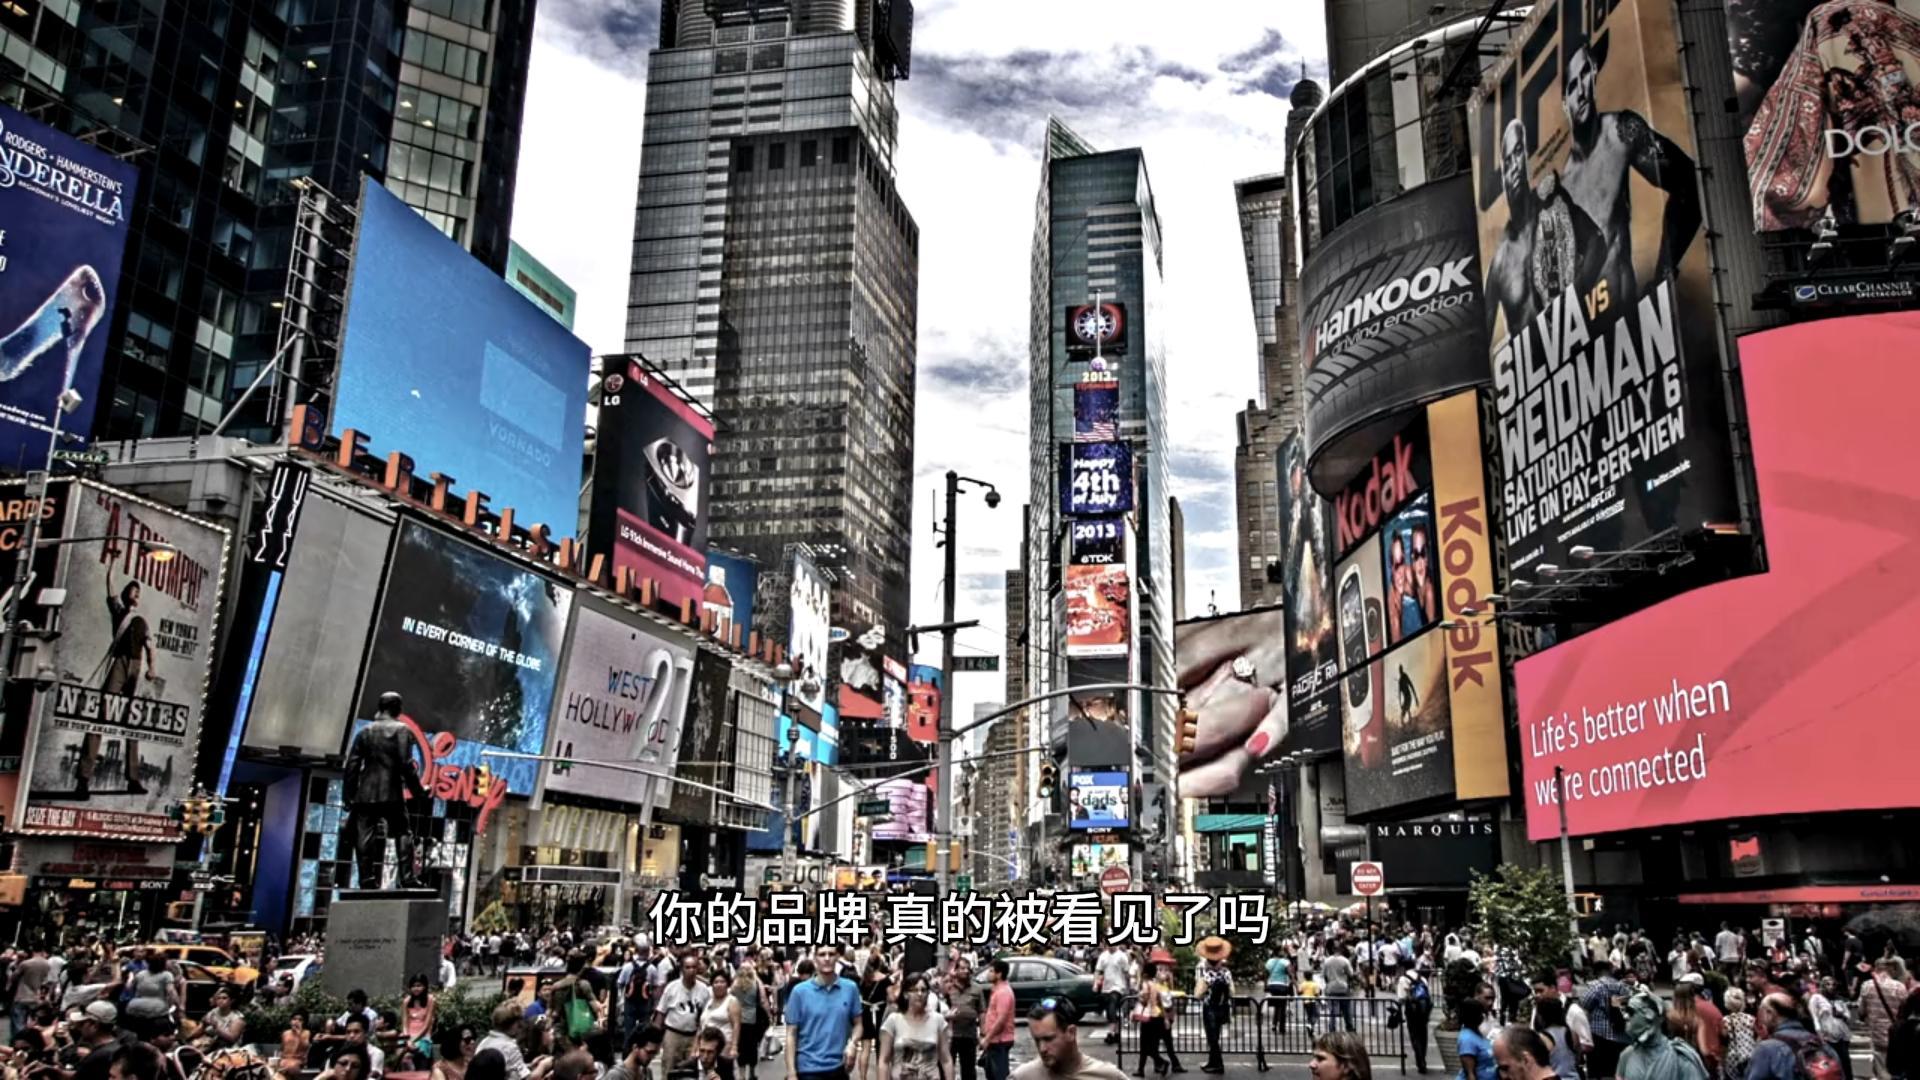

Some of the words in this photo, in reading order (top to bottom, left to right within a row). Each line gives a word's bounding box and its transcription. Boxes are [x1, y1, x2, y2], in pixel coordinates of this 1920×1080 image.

[5, 131, 47, 160] RODGERS
[57, 155, 123, 194] HAMMERSTEIN'S
[1332, 319, 1380, 358] driving
[1384, 291, 1474, 328] emotion
[1494, 283, 1590, 416] SILVA
[1585, 279, 1609, 321] VS
[604, 395, 620, 406] LG
[1499, 279, 1677, 481] WEIDMAN
[1504, 423, 1595, 517] SATURDAY
[1601, 377, 1654, 451] JULY
[1663, 362, 1681, 408] 6
[1073, 458, 1116, 470] Happy
[1073, 468, 1120, 492] 4th
[1506, 510, 1538, 547] LIVE
[1539, 489, 1560, 526] ON
[1562, 405, 1686, 513] PAY-PER-VIEW
[1073, 492, 1088, 504] of
[1088, 492, 1117, 508] July
[1335, 434, 1419, 552] Kodak
[1075, 523, 1116, 539] 2013
[1440, 496, 1494, 692] Kodak
[159, 618, 174, 633] NEW
[402, 616, 412, 633] IN
[415, 619, 448, 642] EVERY
[448, 629, 484, 656] CORNER
[485, 639, 498, 658] OF
[499, 644, 515, 664] THE
[515, 648, 541, 671] GLOBE
[608, 665, 655, 703] WEST
[1291, 672, 1323, 698] PACIFIC
[57, 685, 188, 733] NEWSIES
[1530, 713, 1579, 758] Life's
[1583, 699, 1647, 745] better
[1653, 677, 1731, 725] when
[552, 740, 573, 777] LA
[1535, 771, 1583, 806] were
[1589, 733, 1707, 798] connected
[1082, 793, 1117, 806] dads
[1377, 824, 1493, 837] MARQUIS
[140, 880, 170, 889] SONY
